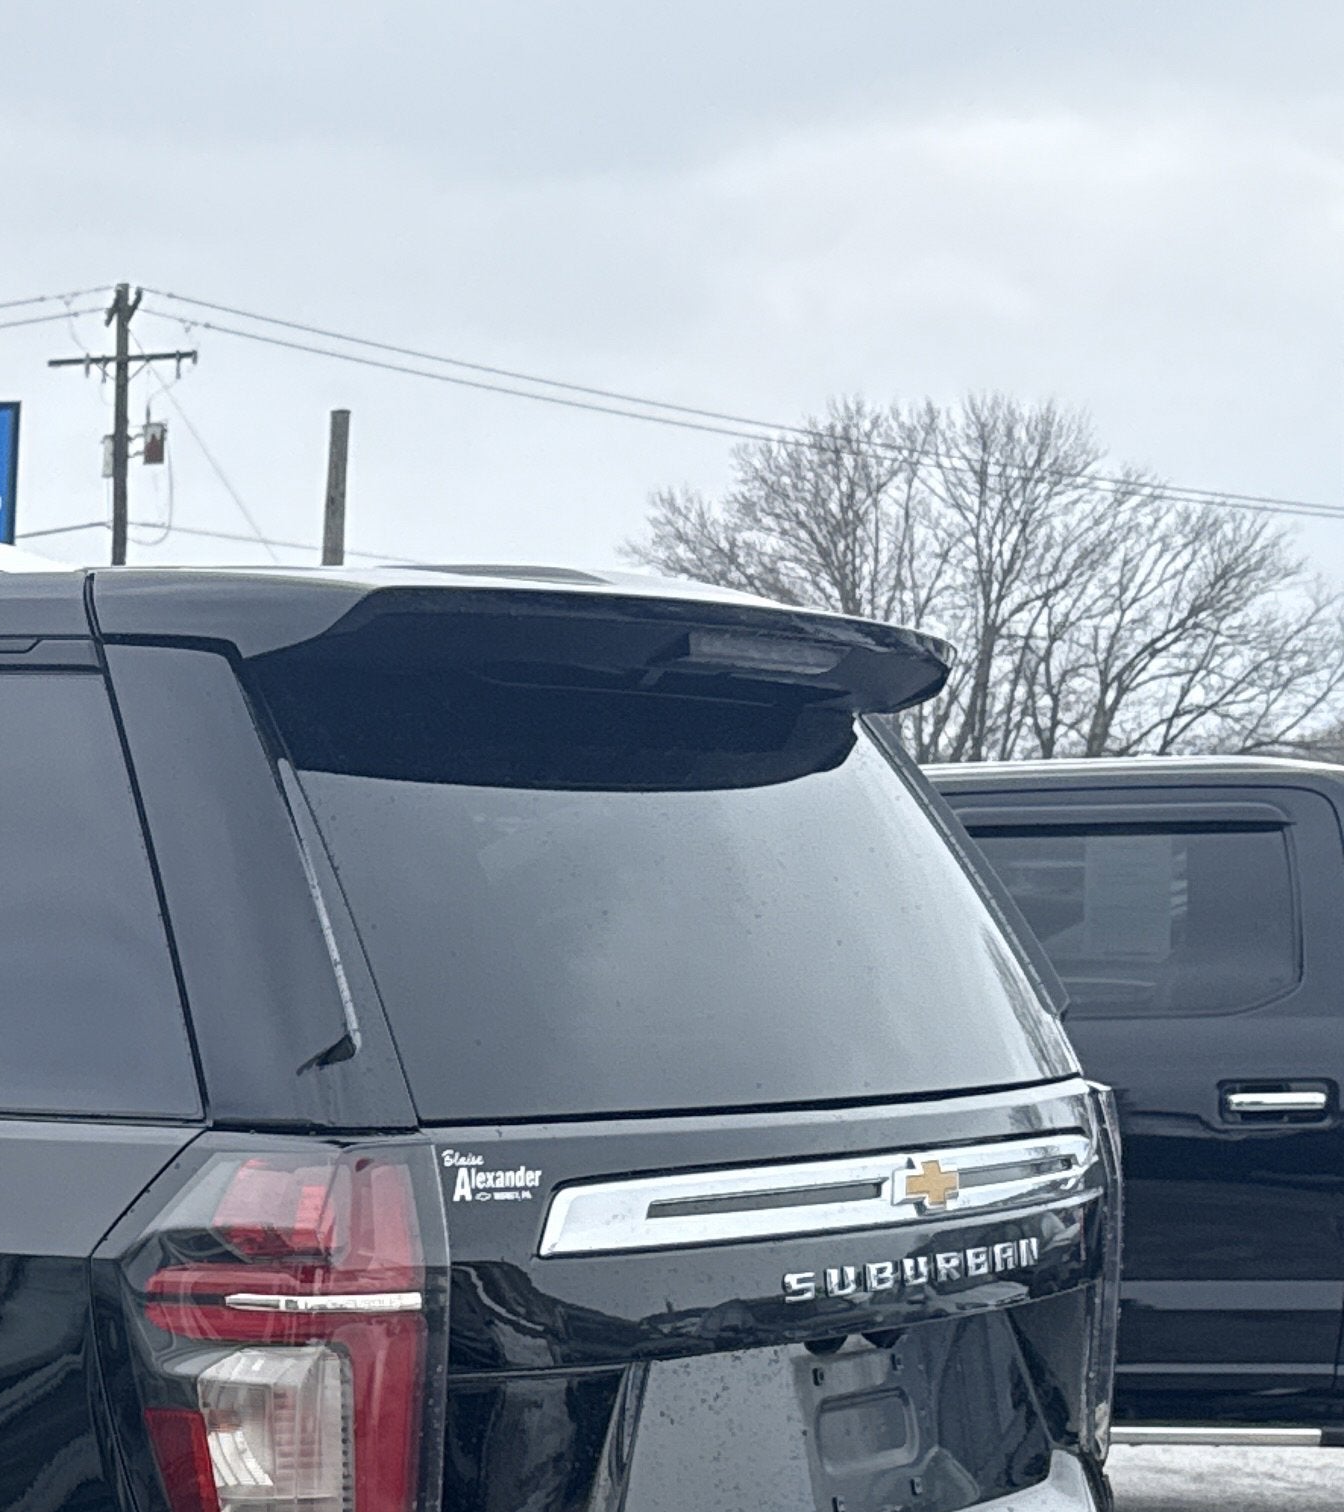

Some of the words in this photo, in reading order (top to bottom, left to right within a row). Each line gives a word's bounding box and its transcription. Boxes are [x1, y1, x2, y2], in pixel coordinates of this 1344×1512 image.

[441, 1149, 485, 1167] Blaise
[453, 1165, 542, 1201] Alexander
[782, 1237, 1039, 1303] SUBURBAN
